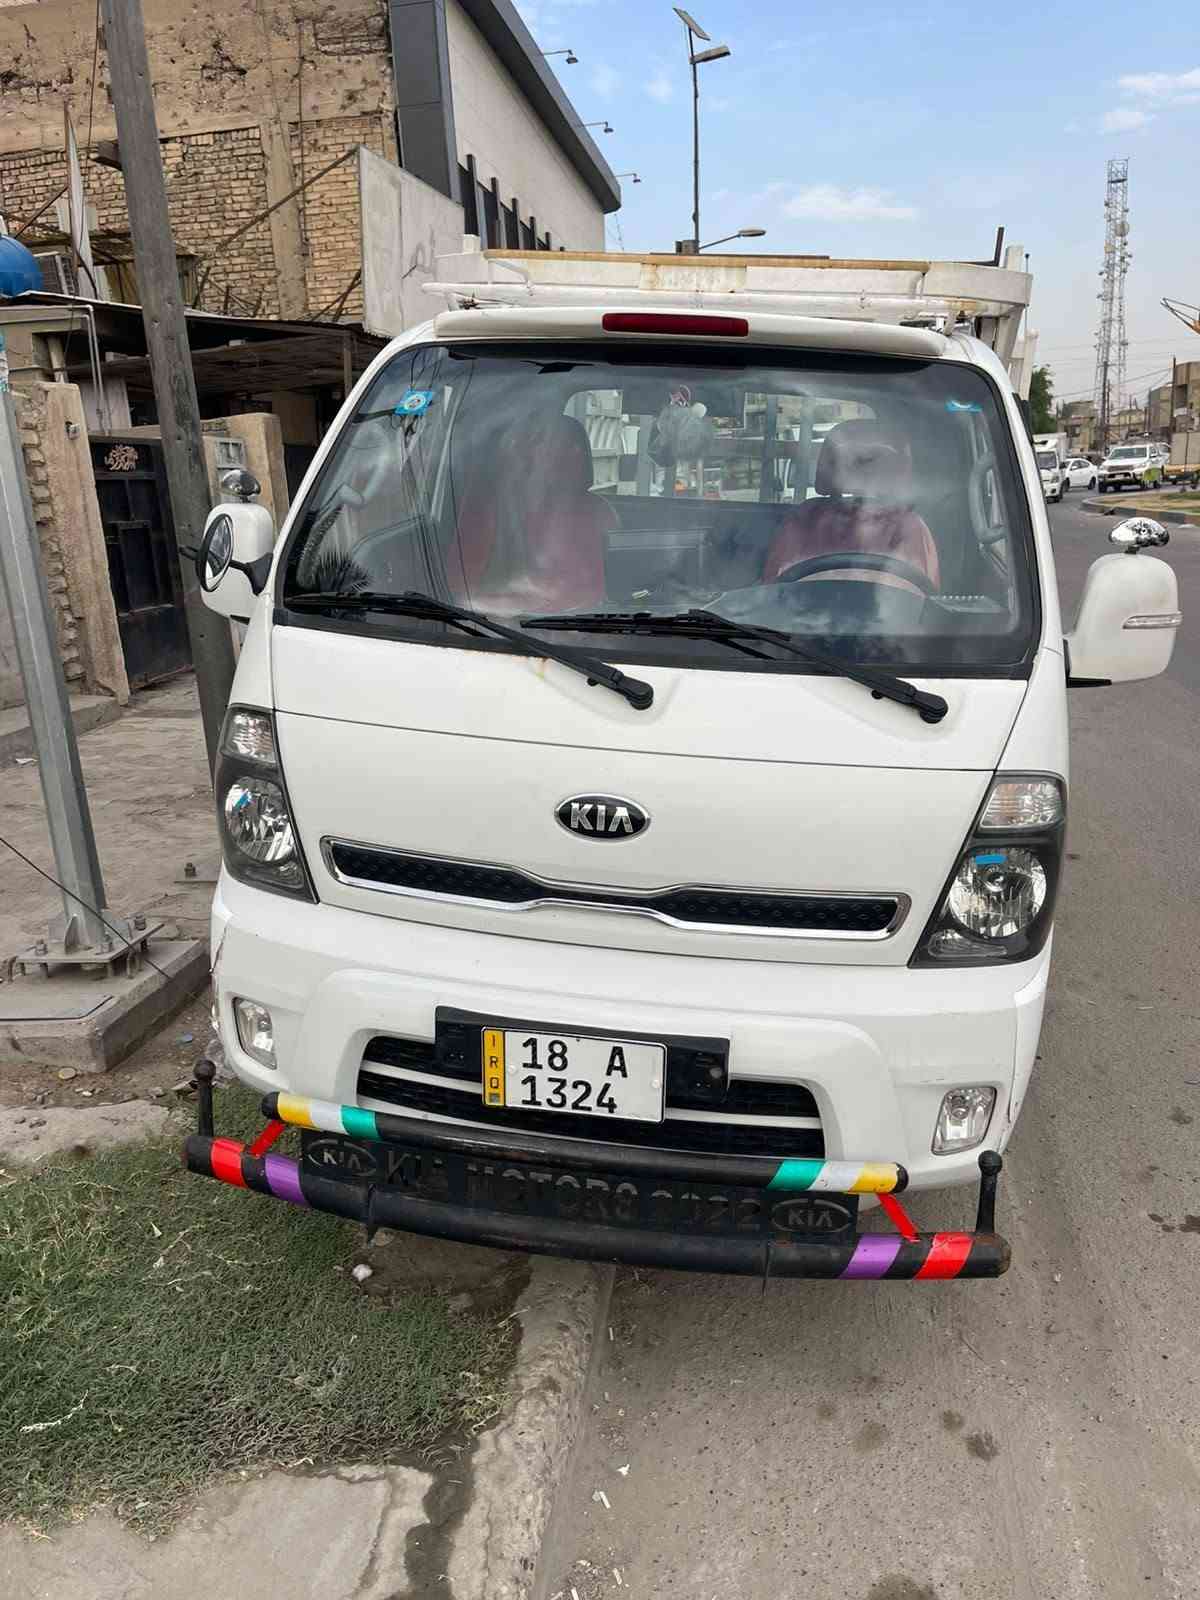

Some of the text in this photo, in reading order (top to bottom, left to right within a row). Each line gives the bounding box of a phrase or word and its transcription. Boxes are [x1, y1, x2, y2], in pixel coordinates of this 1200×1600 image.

[570, 802, 634, 832] KIA
[522, 1037, 629, 1079] 18 A
[521, 1075, 618, 1114] 1324
[323, 1148, 362, 1171] KIA
[789, 1208, 833, 1228] KIA
